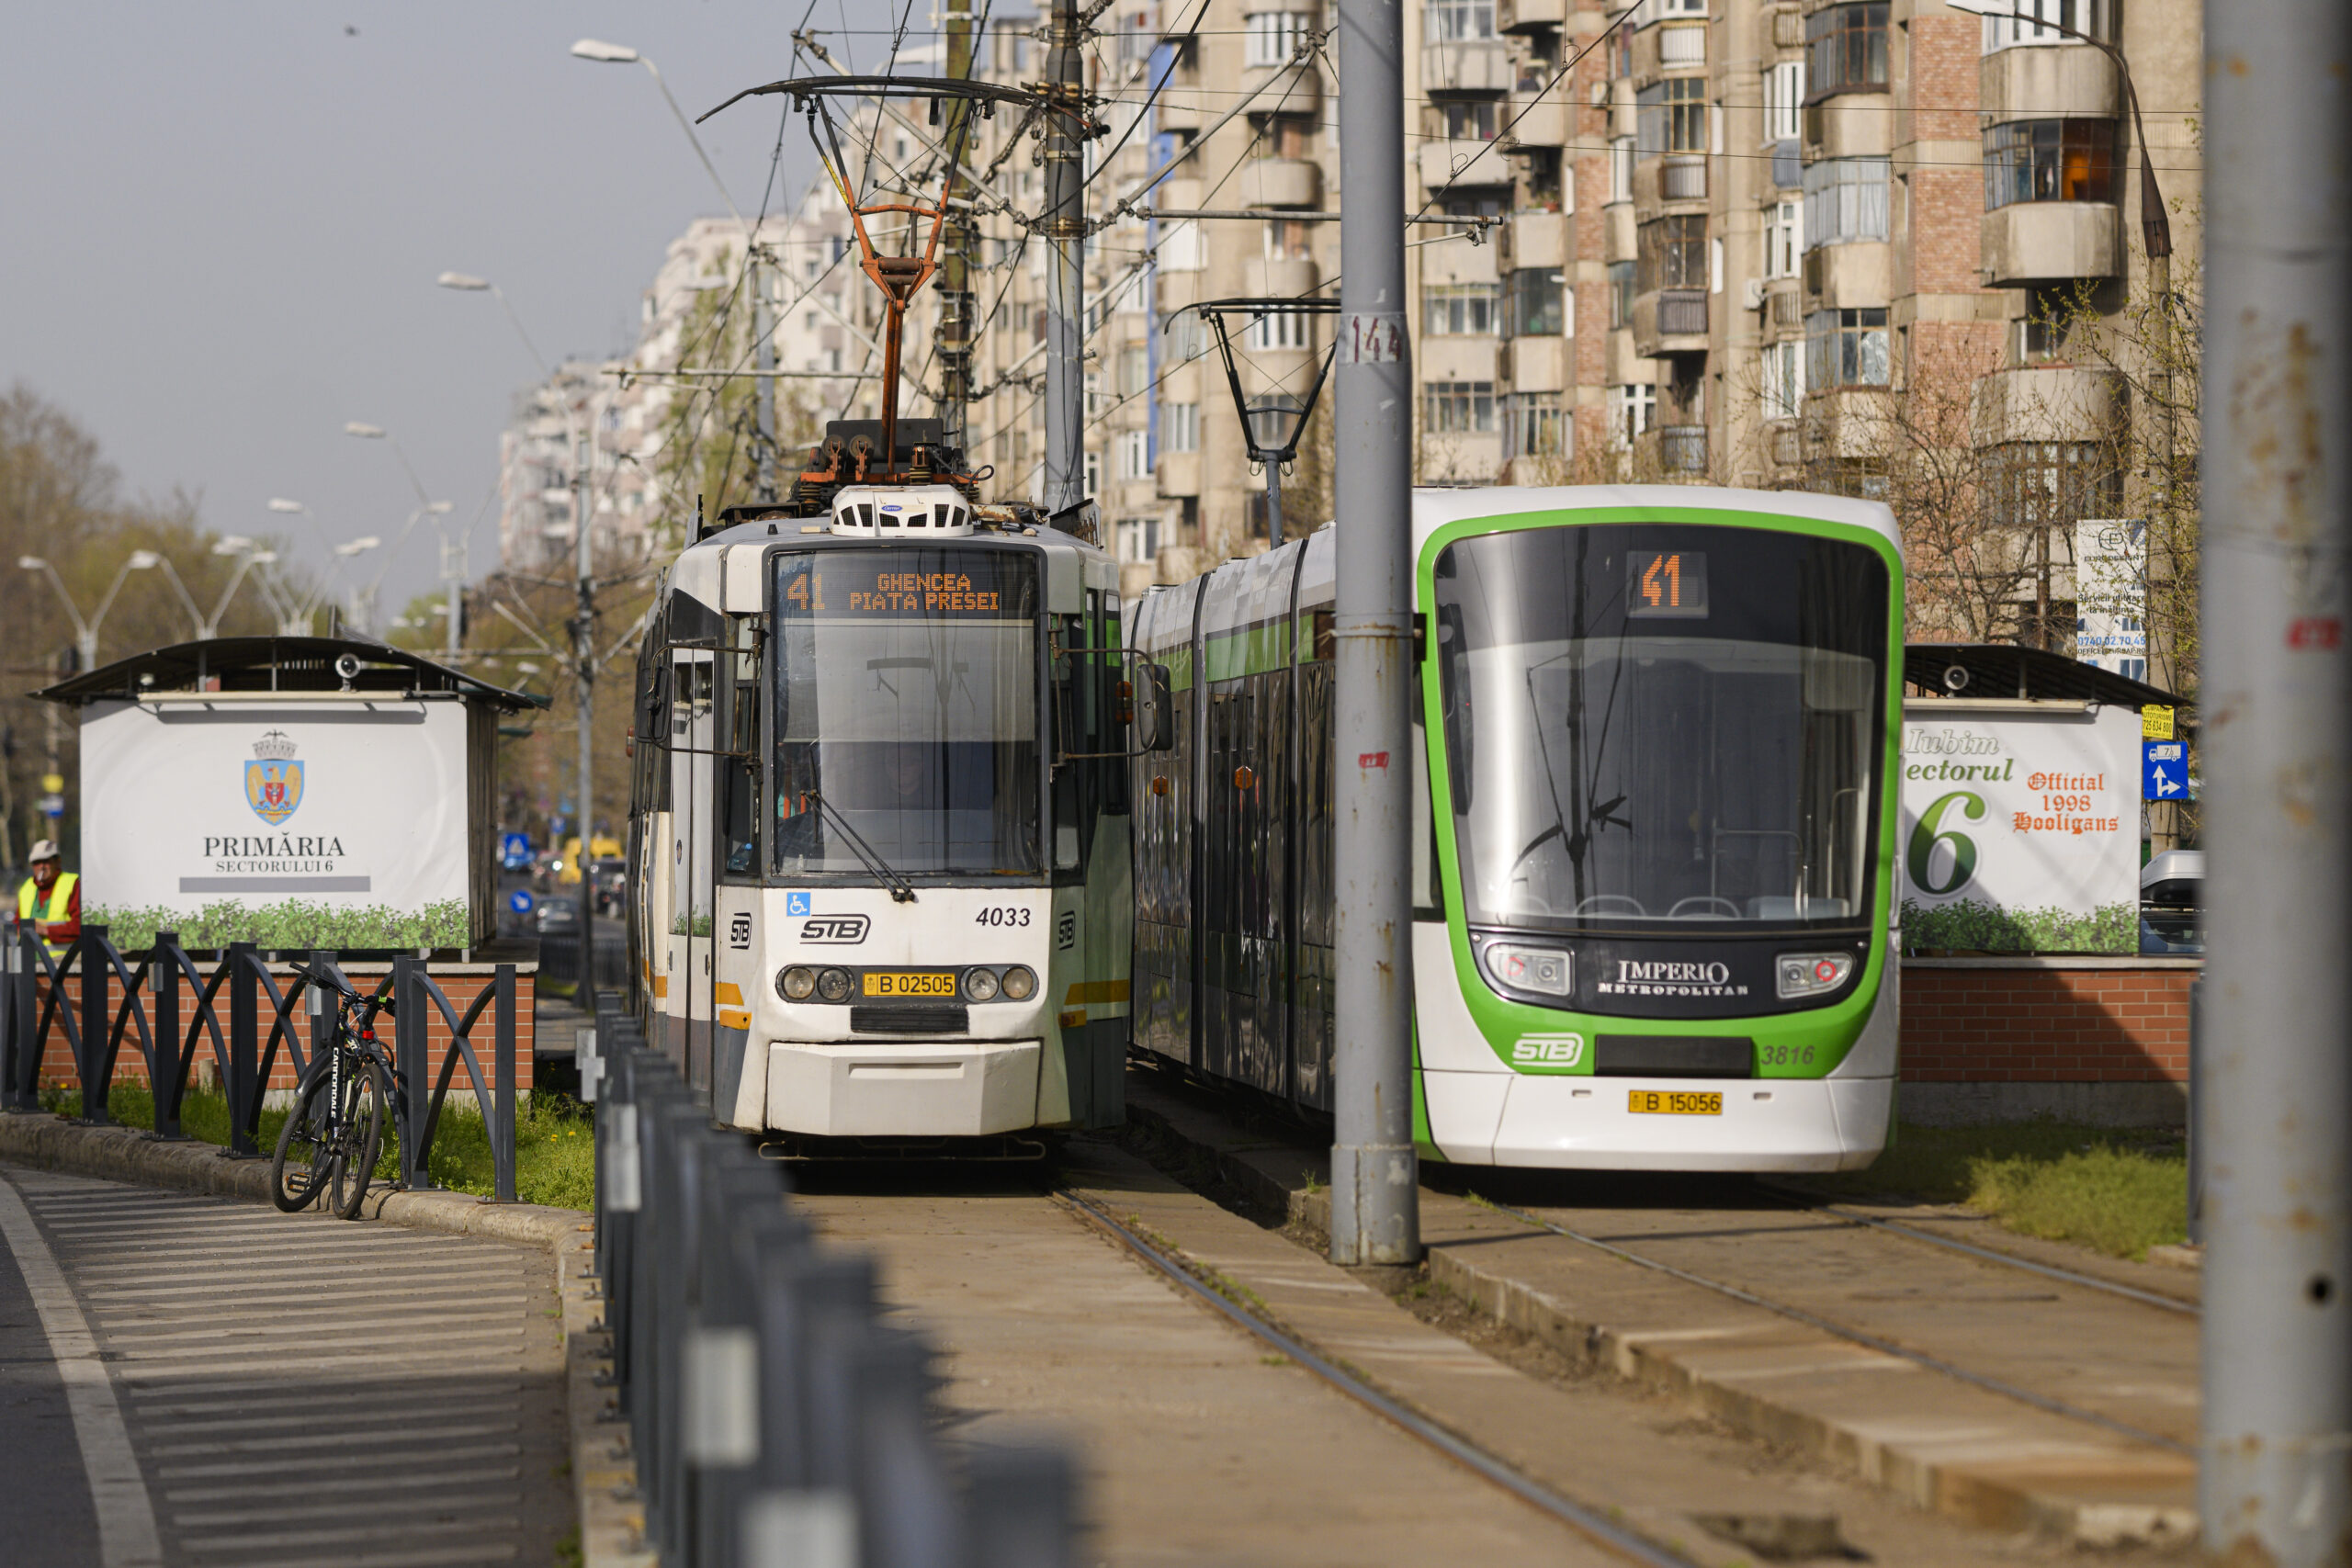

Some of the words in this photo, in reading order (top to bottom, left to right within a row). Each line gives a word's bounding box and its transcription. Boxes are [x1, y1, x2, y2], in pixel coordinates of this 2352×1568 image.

[877, 573, 971, 591] GHENCEA
[1643, 554, 1679, 606] 41
[787, 573, 825, 610] 41
[850, 592, 918, 610] PIATA
[925, 592, 999, 610] PRESEI
[1905, 728, 1999, 755] Iubim
[1905, 758, 2014, 782] ectorul
[2027, 772, 2105, 791] Official
[2042, 795, 2091, 812] 1998
[2012, 812, 2119, 835] Hooligans
[203, 831, 345, 857] PRIMĂRIA
[1907, 791, 1986, 895] 6
[216, 861, 320, 873] SECTORULUI
[324, 860, 334, 873] 6
[976, 907, 1031, 927] 4033
[730, 919, 751, 942] STB
[800, 919, 864, 939] STB
[1058, 918, 1074, 943] STB
[1617, 960, 1729, 986] IMPERIO
[879, 976, 892, 993] B
[899, 976, 954, 993] 02505
[1597, 983, 1748, 996] METROPOLITAN
[1512, 1038, 1577, 1060] STB
[1760, 1044, 1815, 1066] 3816
[1646, 1093, 1660, 1111] B
[1668, 1094, 1721, 1112] 15056
